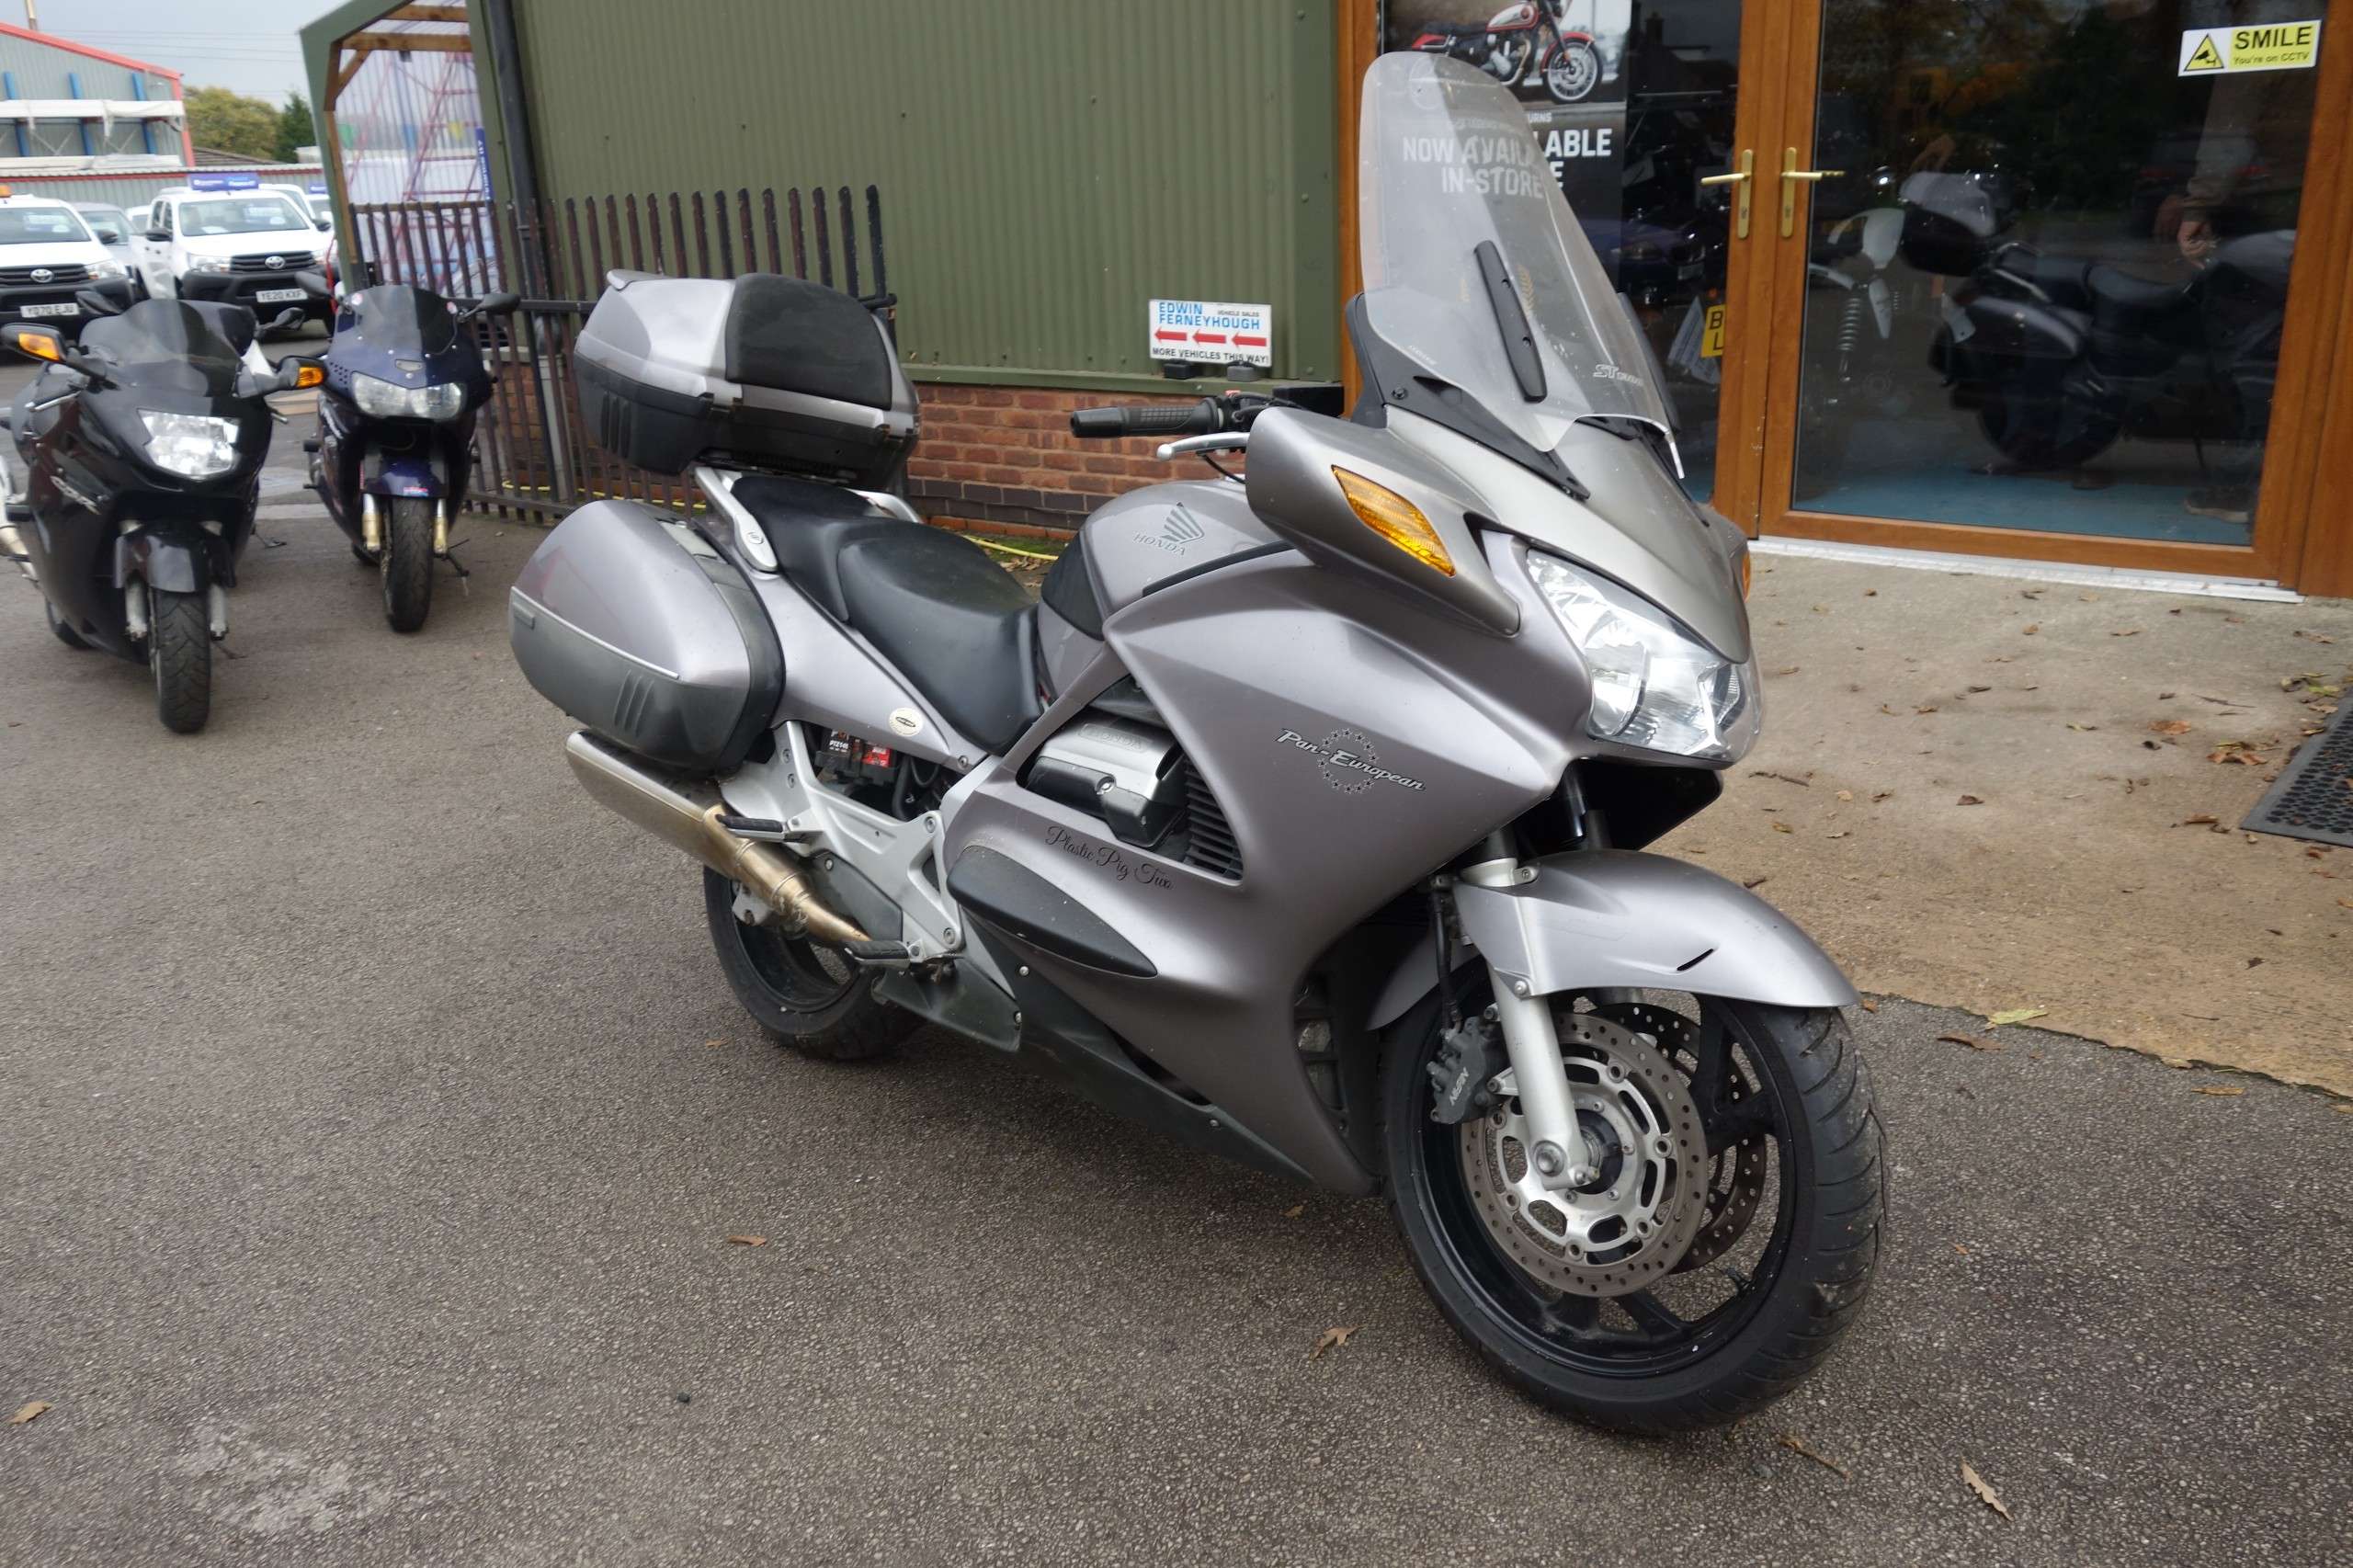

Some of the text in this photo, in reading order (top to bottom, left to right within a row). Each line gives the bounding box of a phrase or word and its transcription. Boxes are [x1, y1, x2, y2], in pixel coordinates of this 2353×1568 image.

[2234, 26, 2313, 50] SMILE
[2234, 51, 2310, 65] You're on CCTV
[1403, 137, 1454, 164] NOW
[1441, 165, 1545, 199] IN-STORE
[1159, 301, 1203, 315] EDWIN
[1159, 313, 1260, 330] FERNEYHOUGH
[1152, 347, 1176, 357] MORE
[1178, 348, 1222, 360] VEHICLES
[1223, 352, 1244, 361] THIS
[1132, 533, 1187, 556] HONDA
[1272, 728, 1427, 792] Pan-European
[1044, 825, 1174, 890] Plastic Pig Two
